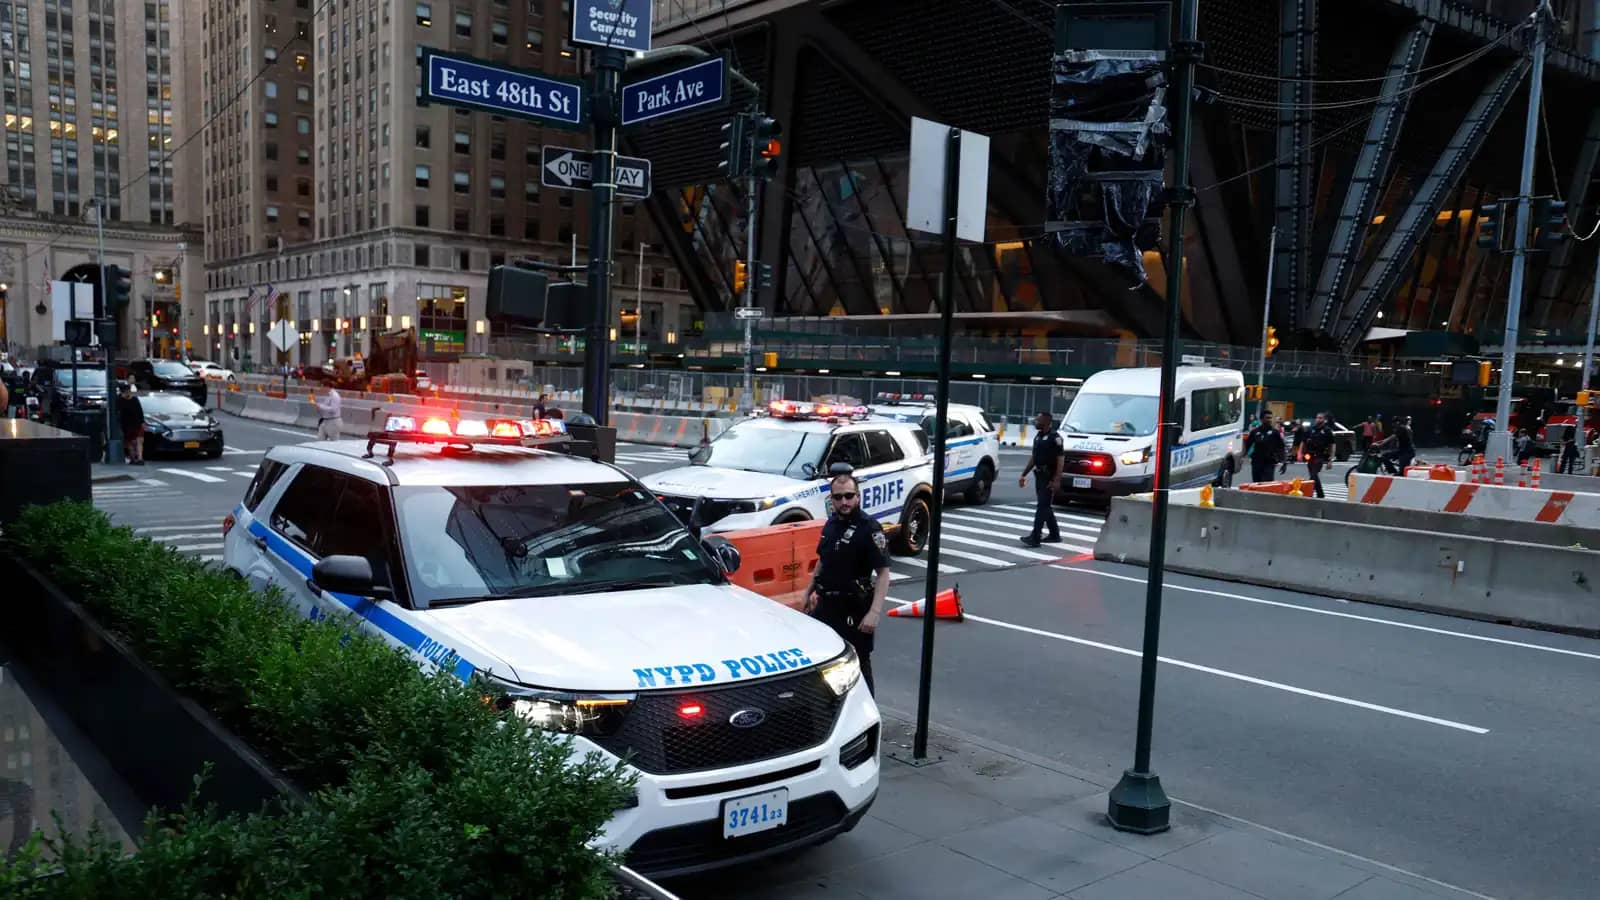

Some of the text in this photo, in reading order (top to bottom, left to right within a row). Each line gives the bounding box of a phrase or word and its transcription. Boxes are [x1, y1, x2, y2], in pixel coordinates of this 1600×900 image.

[590, 20, 637, 38] Camera
[440, 67, 571, 114] East 48th St
[637, 80, 704, 112] Park Ave
[558, 160, 640, 185] ONE AY
[862, 479, 904, 510] ERIFF
[632, 647, 812, 687] NYPD POLICE
[729, 803, 768, 828] 3741
